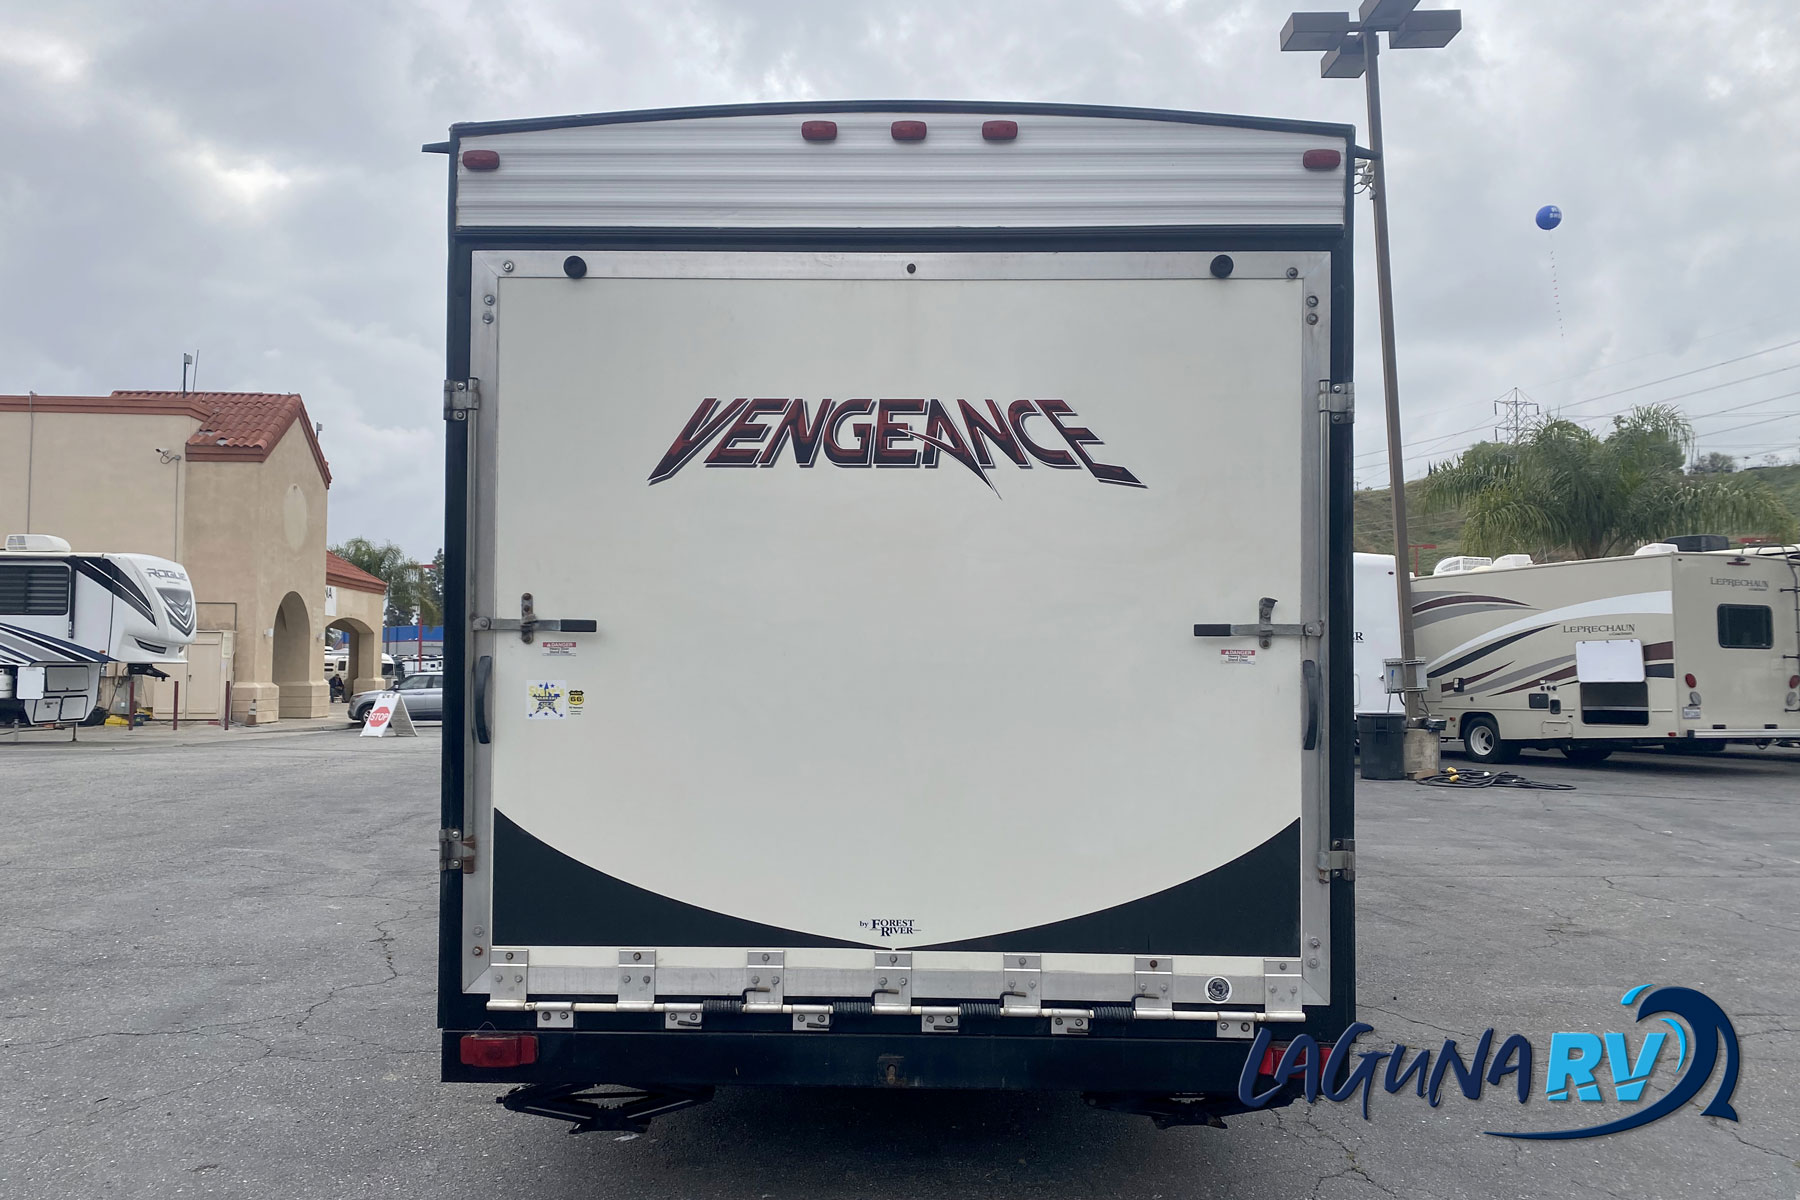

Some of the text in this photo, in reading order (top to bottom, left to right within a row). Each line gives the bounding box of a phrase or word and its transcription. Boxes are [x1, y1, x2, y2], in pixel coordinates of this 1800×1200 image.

[648, 398, 1148, 500] VENGEANCE
[1563, 624, 1636, 633] LEPRECHAUN
[370, 712, 389, 721] STOP
[859, 919, 915, 929] by FOREST
[881, 926, 914, 937] RIVER
